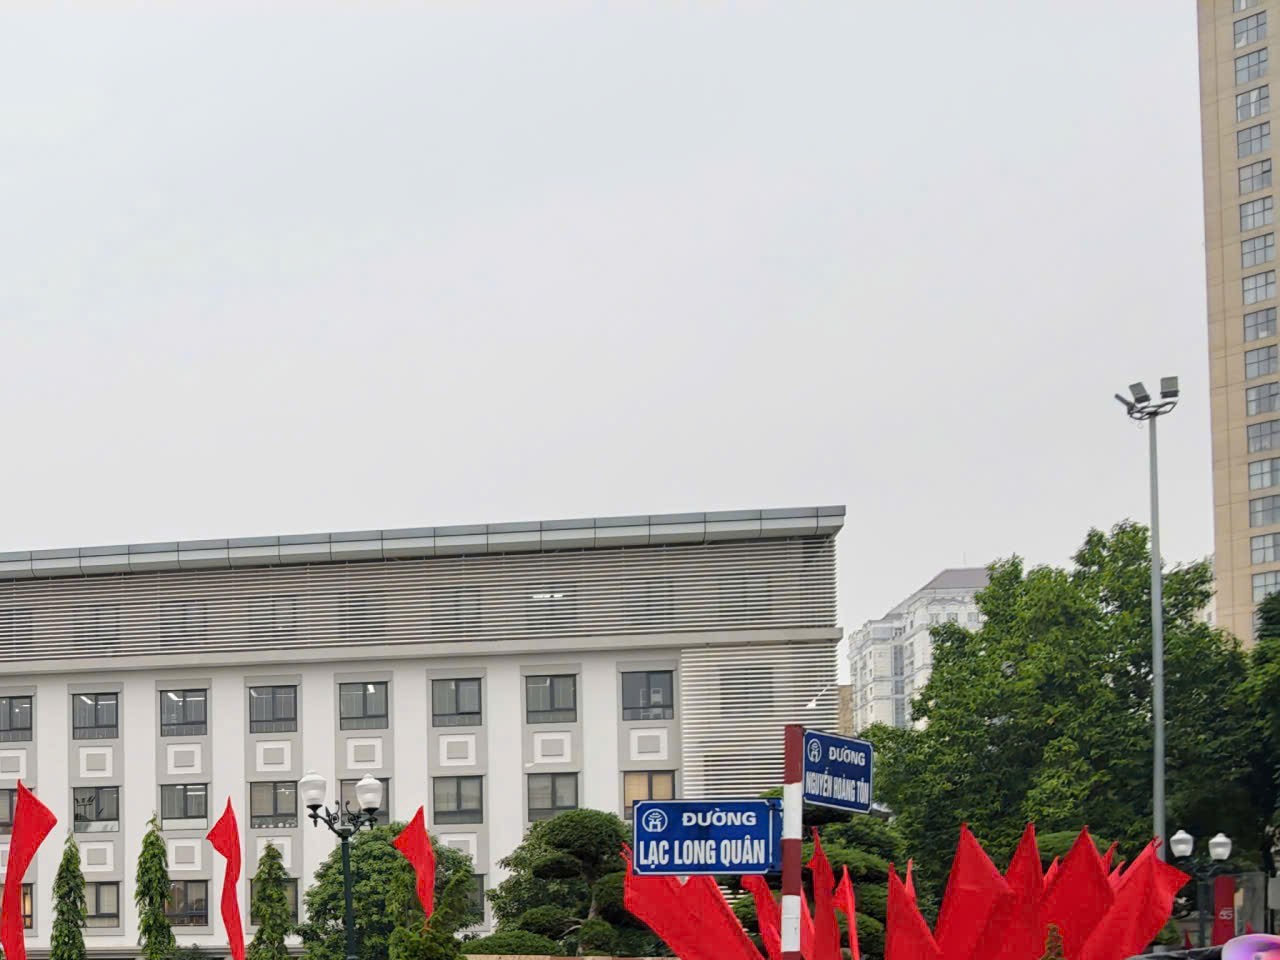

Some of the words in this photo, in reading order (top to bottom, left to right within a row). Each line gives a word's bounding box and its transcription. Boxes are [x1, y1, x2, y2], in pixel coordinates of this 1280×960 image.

[828, 745, 866, 767] ĐƯỜNG
[682, 807, 757, 827] ĐƯỜNG
[639, 839, 670, 869] LẠC
[674, 839, 716, 865] LONG
[720, 834, 765, 865] QUÂN
